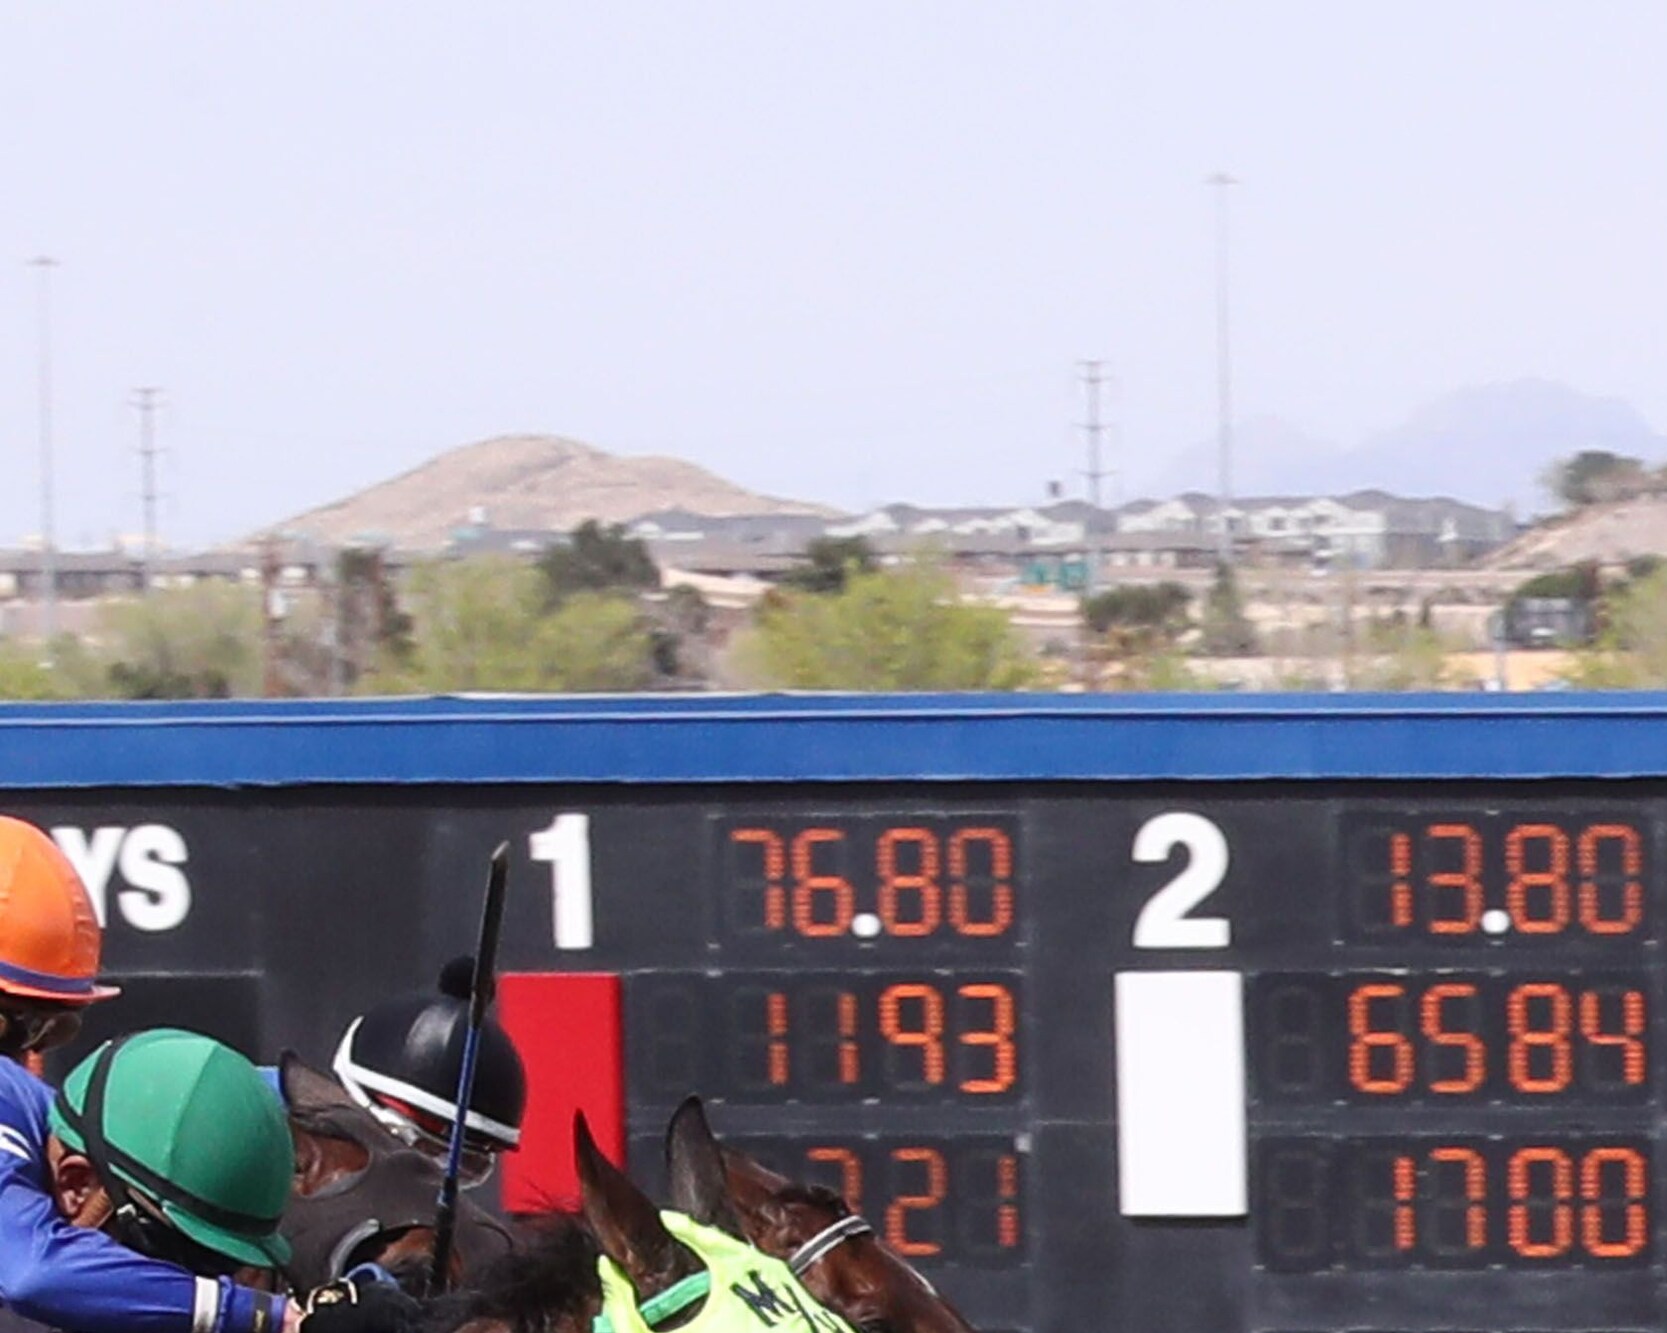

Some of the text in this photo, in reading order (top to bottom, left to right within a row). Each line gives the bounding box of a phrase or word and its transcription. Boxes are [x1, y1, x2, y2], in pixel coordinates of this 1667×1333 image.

[529, 813, 593, 949] 1
[730, 828, 1014, 937] 76.80
[1131, 812, 1231, 949] 2
[1392, 824, 1642, 934] 13.80
[767, 983, 1017, 1093] 1193
[1348, 983, 1646, 1094] 6584
[1393, 1147, 1648, 1257] 1700
